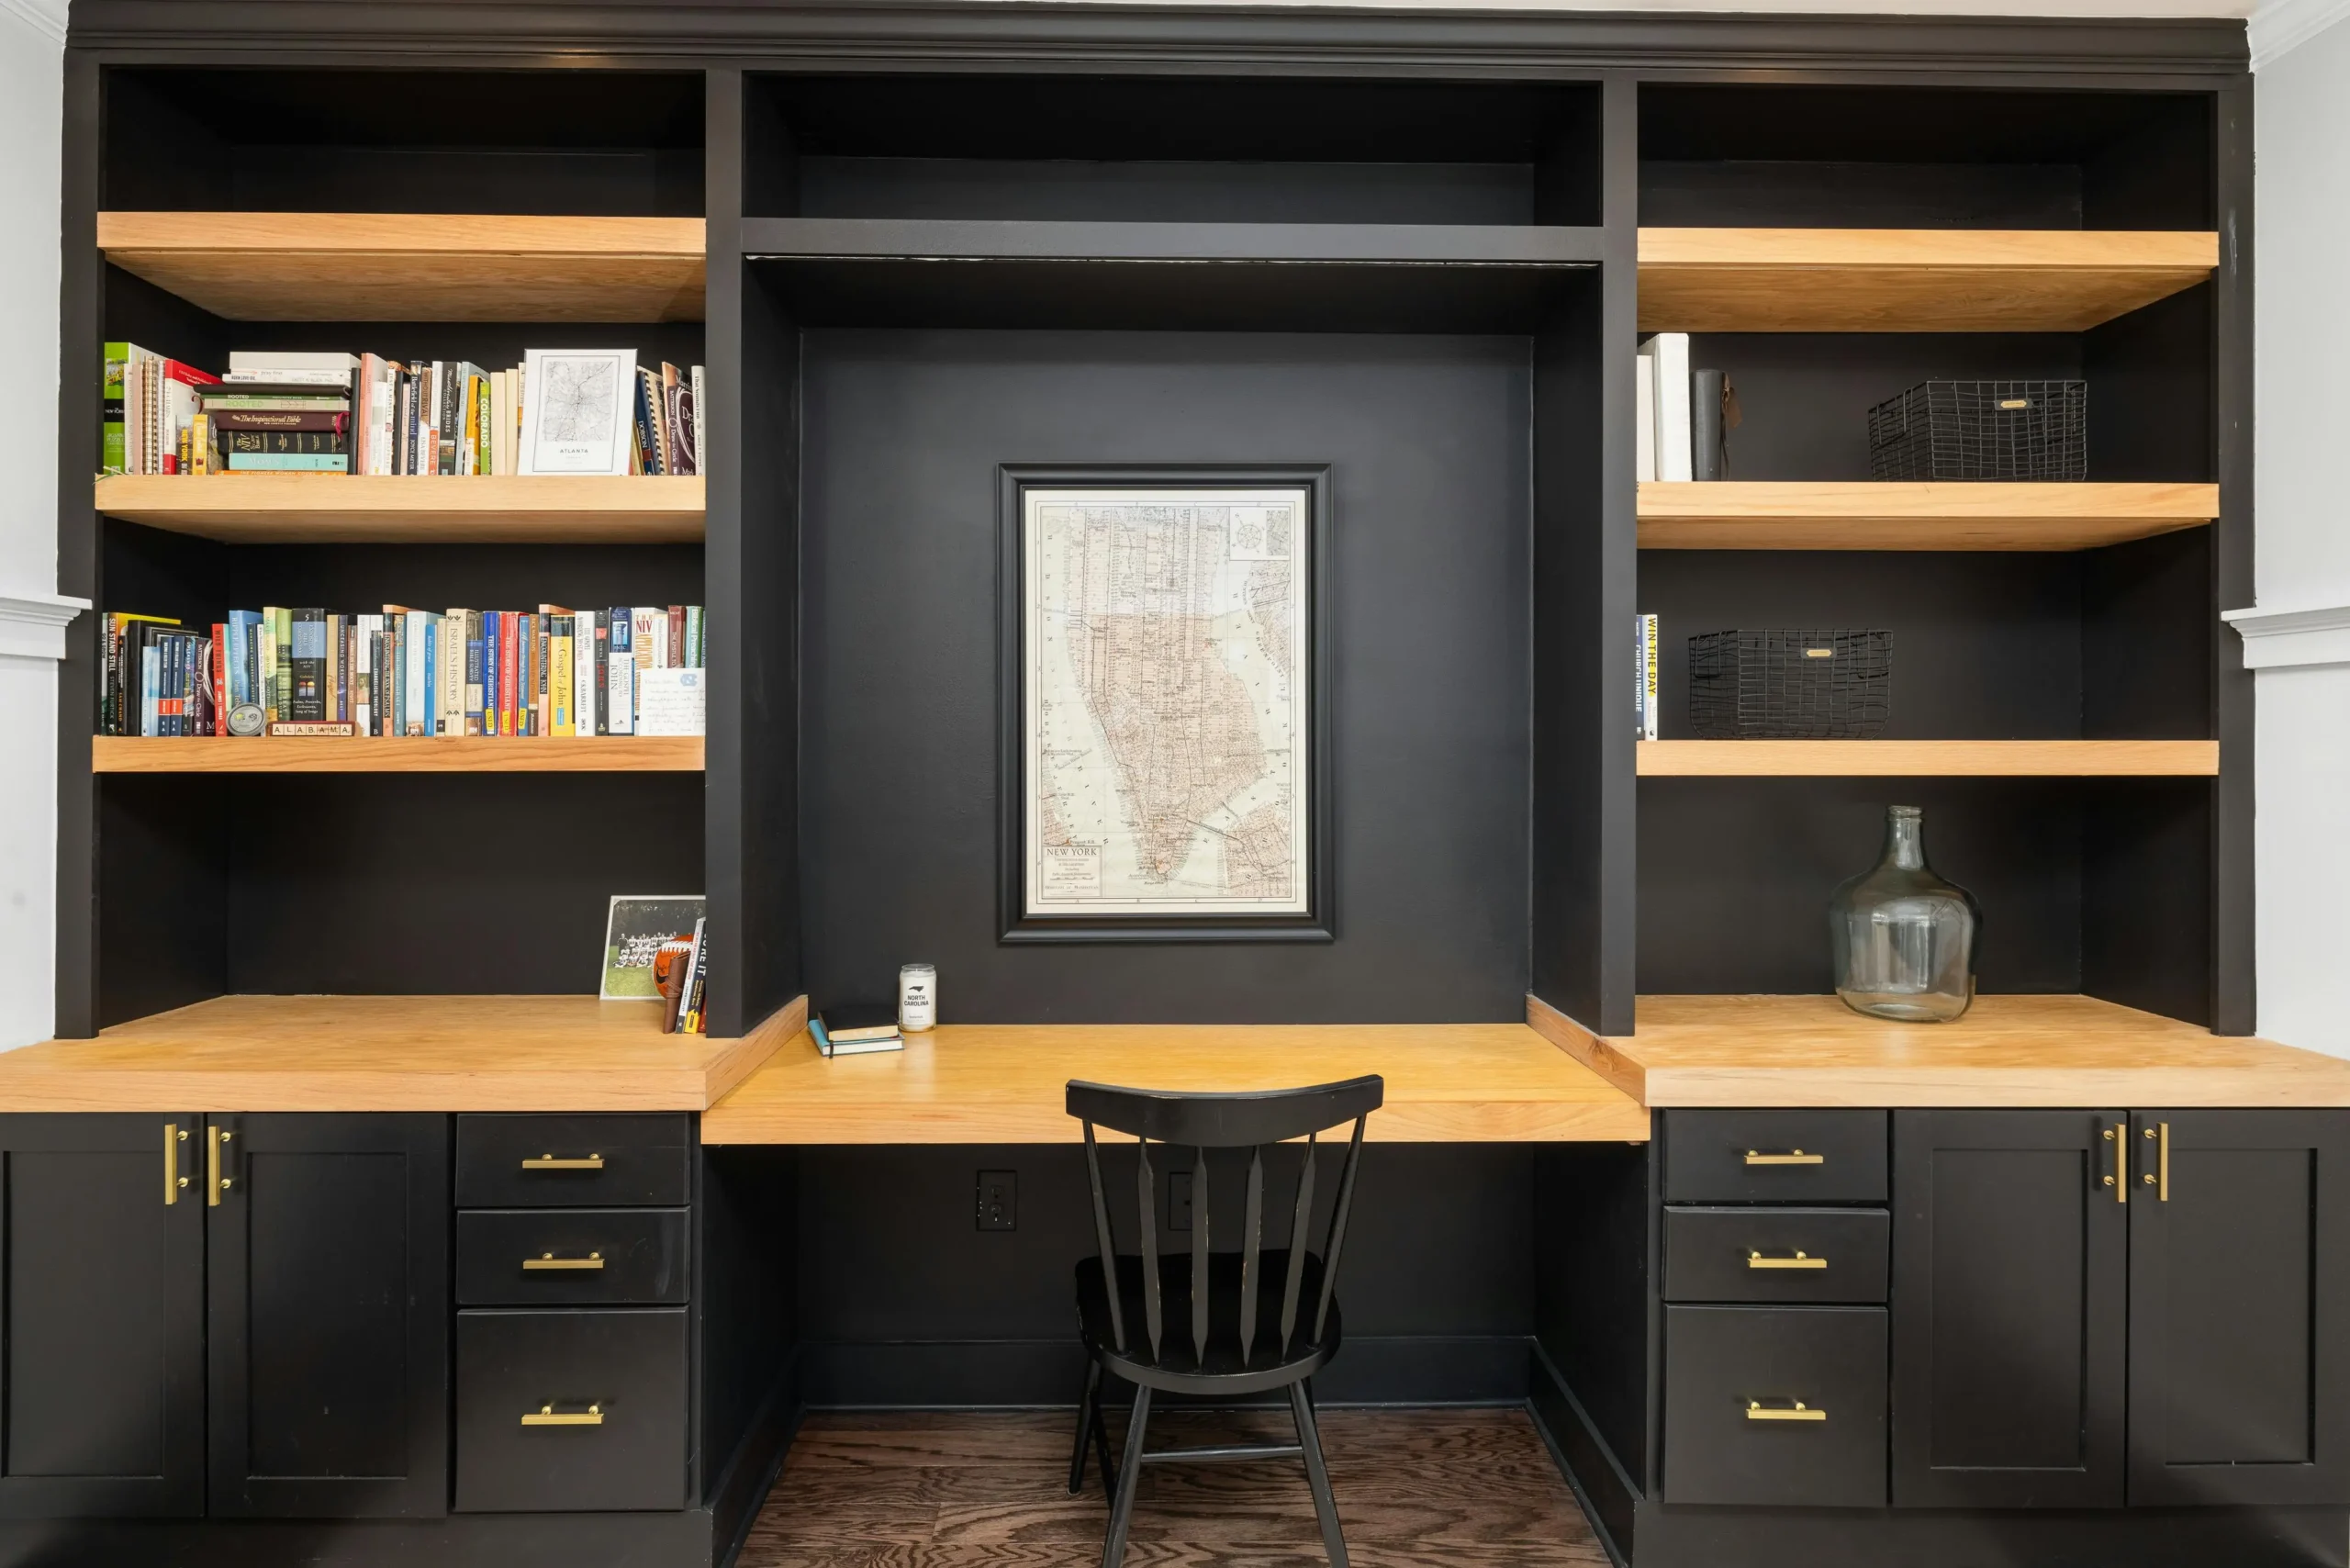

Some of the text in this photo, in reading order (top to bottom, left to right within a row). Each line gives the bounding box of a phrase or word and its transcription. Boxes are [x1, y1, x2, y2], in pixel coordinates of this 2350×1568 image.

[252, 415, 286, 425] Inspirational
[286, 415, 302, 423] Bible
[409, 417, 418, 435] mind
[638, 420, 647, 449] DOBSON
[636, 621, 653, 633] NIV
[449, 628, 458, 701] ISRAEL'S HISTORY
[557, 649, 567, 678] Gospel
[1648, 618, 1657, 695] WIN THE DAY
[488, 667, 494, 676] OF
[505, 667, 510, 676] OF
[597, 664, 605, 689] JOHN
[557, 686, 567, 706] John
[1072, 848, 1097, 857] YORK
[698, 965, 707, 977] IT
